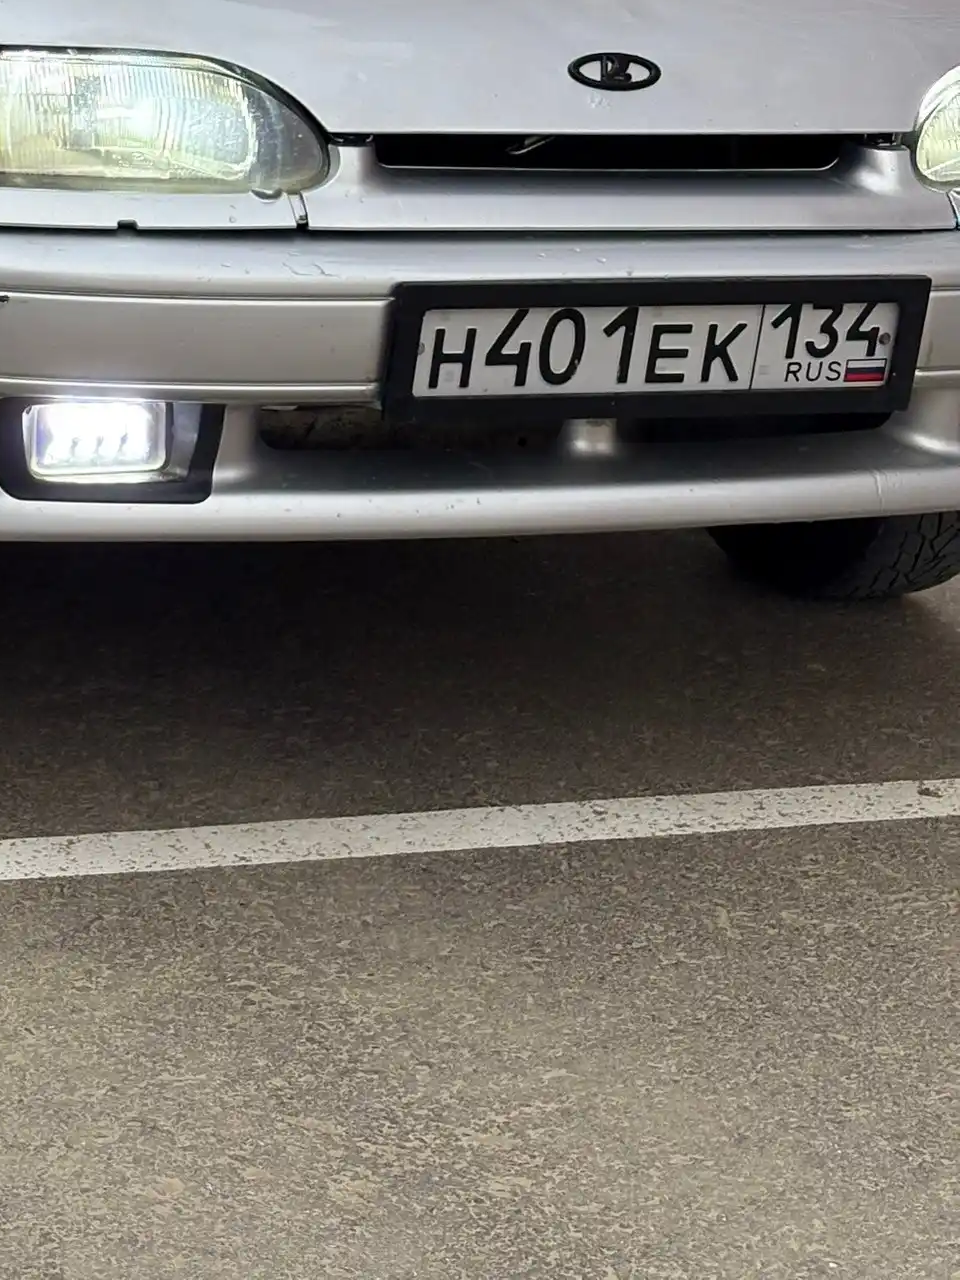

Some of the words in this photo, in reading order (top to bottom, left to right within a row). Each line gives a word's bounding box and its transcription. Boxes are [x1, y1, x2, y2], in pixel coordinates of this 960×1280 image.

[428, 306, 748, 388] H401EK
[771, 303, 881, 359] 134
[784, 361, 842, 382] RUS
